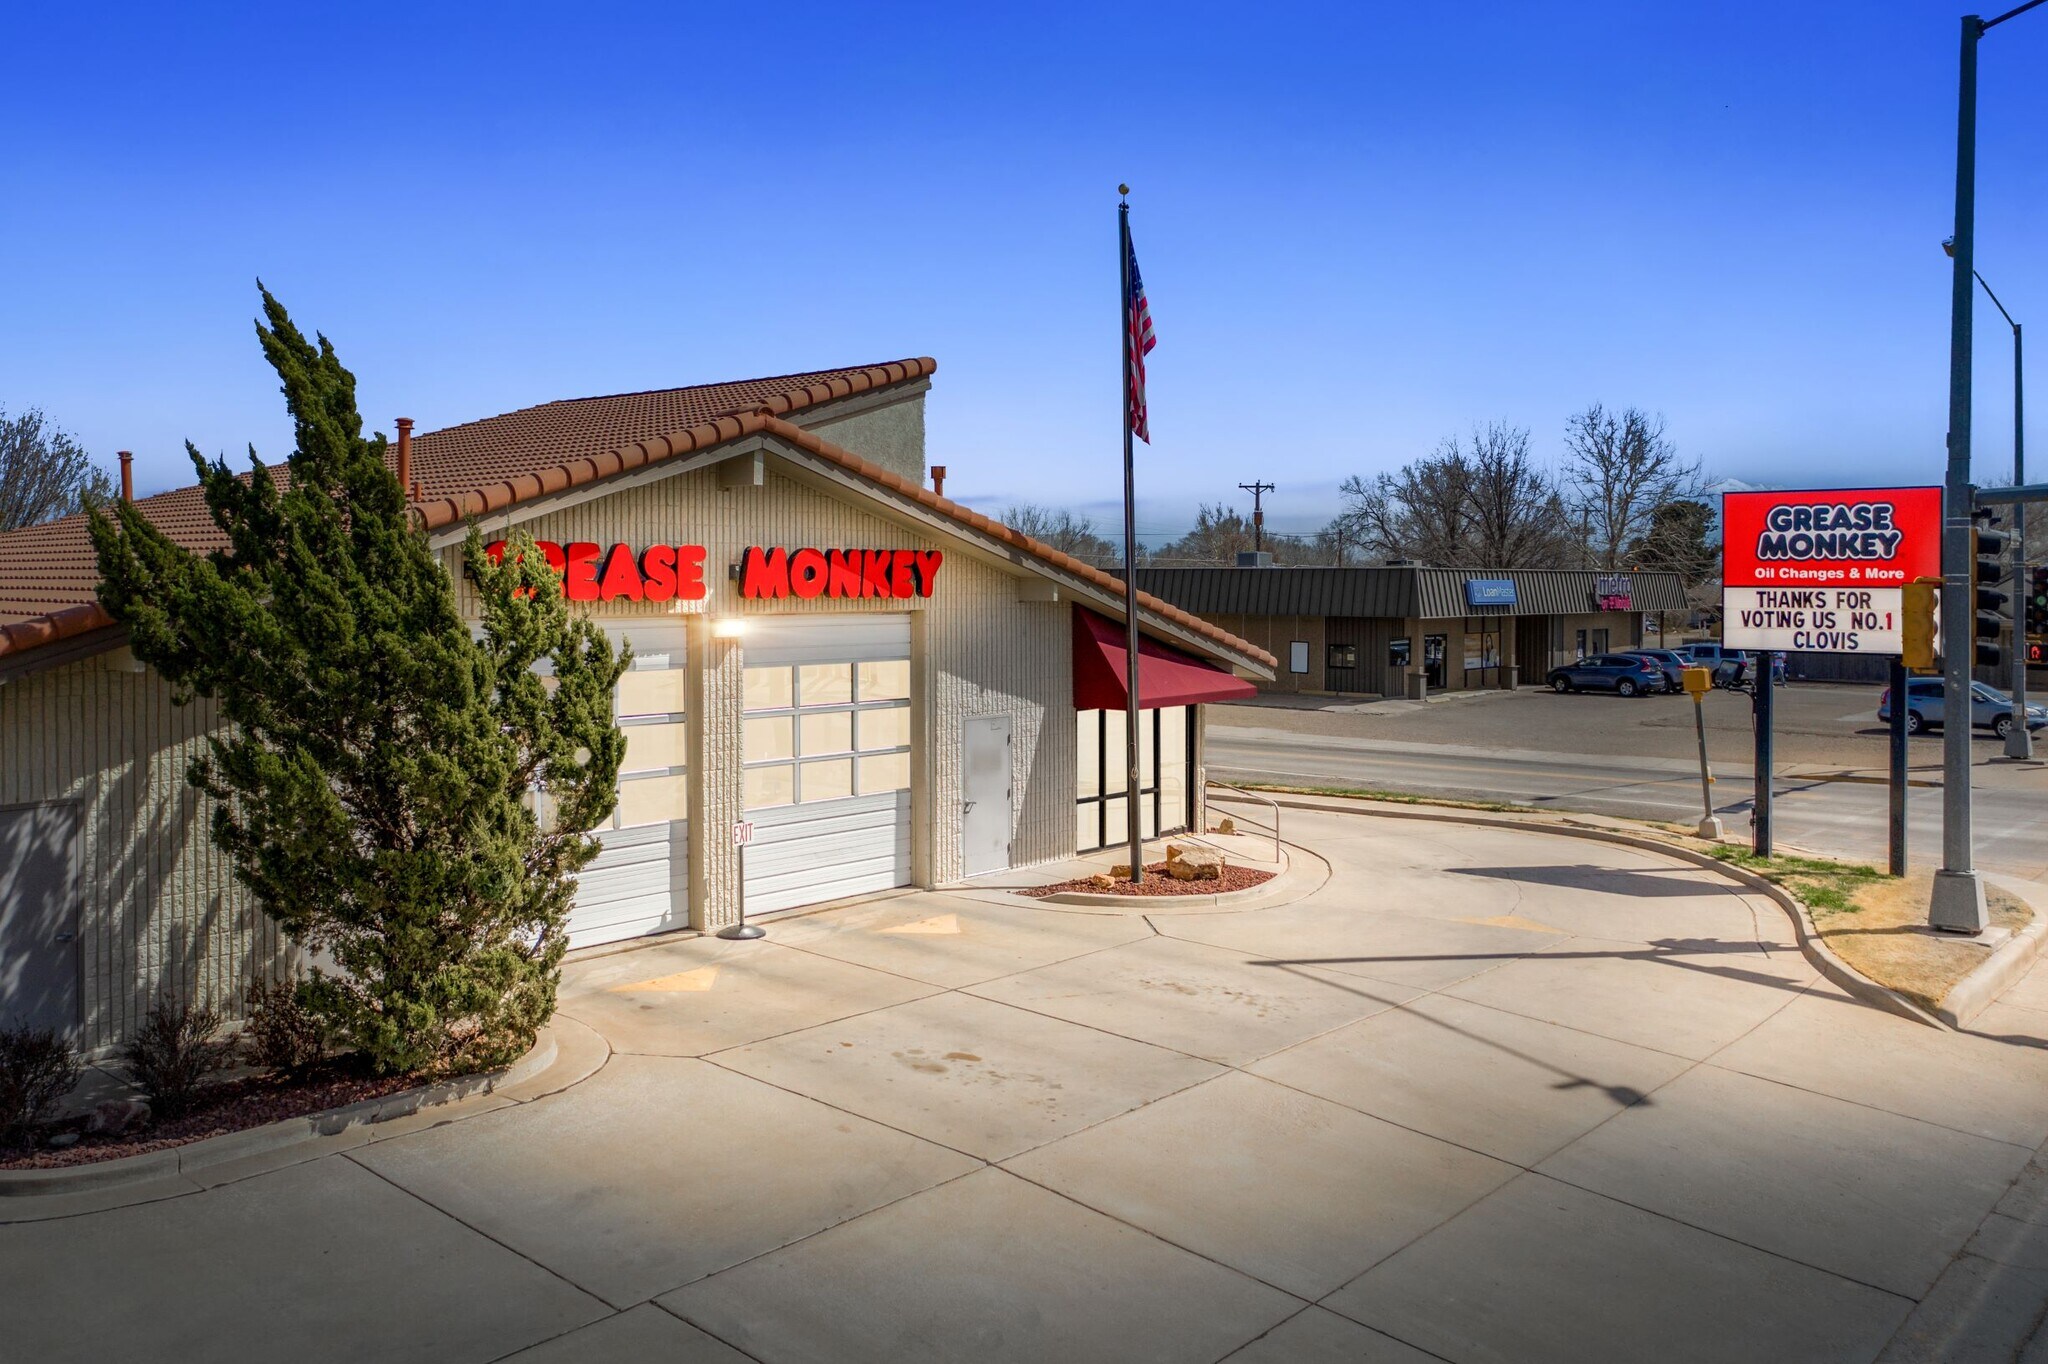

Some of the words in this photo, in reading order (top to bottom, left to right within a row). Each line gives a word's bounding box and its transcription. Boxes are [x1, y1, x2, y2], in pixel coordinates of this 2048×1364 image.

[1767, 504, 1893, 532] GREASE
[1757, 531, 1901, 560] MONKEY
[480, 540, 707, 602] EASE
[739, 545, 943, 599] MONKEY
[1754, 568, 1774, 579] Oil
[1779, 567, 1845, 582] Changes
[1849, 568, 1860, 579] &
[1865, 568, 1905, 580] More
[1756, 591, 1826, 608] THANKS
[1836, 592, 1871, 609] FOR
[1741, 611, 1805, 628] VOTING
[1813, 612, 1836, 629] US
[1793, 631, 1858, 649] CLOVIS
[735, 823, 754, 844] EXIT
